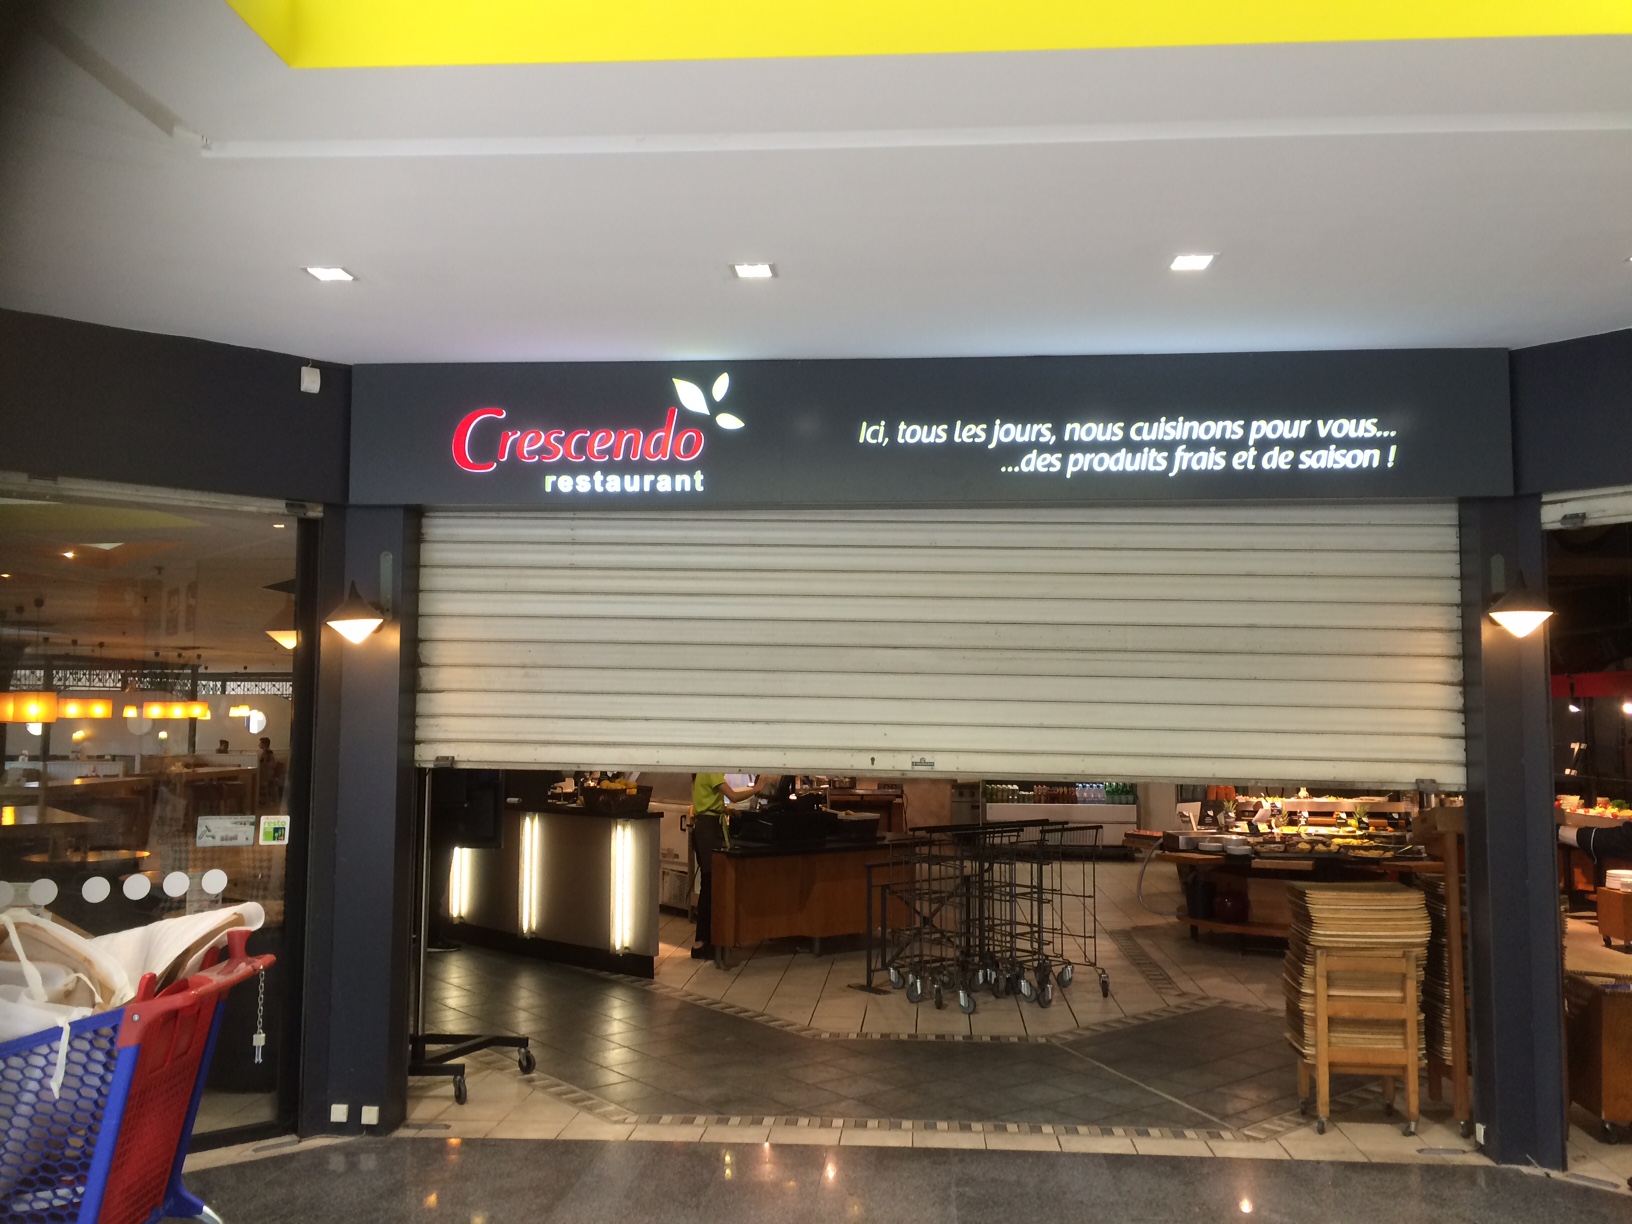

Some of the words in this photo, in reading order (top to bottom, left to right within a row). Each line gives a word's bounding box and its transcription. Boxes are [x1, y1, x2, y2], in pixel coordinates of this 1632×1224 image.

[451, 406, 705, 473] Crescendo
[858, 420, 889, 447] Ici,
[896, 420, 948, 443] tous
[953, 419, 988, 443] les
[988, 418, 1057, 449] jours,
[1063, 421, 1125, 443] nous
[1129, 416, 1245, 441] cuisinons
[1248, 417, 1312, 447] pour
[1317, 417, 1397, 439] vous...
[1000, 448, 1063, 473] ...des
[1065, 447, 1169, 479] produits
[1168, 444, 1227, 478] frais
[1231, 446, 1258, 471] et
[1261, 445, 1295, 470] de
[1298, 445, 1381, 470] saison
[1386, 444, 1398, 468] !
[545, 471, 705, 494] restaurant
